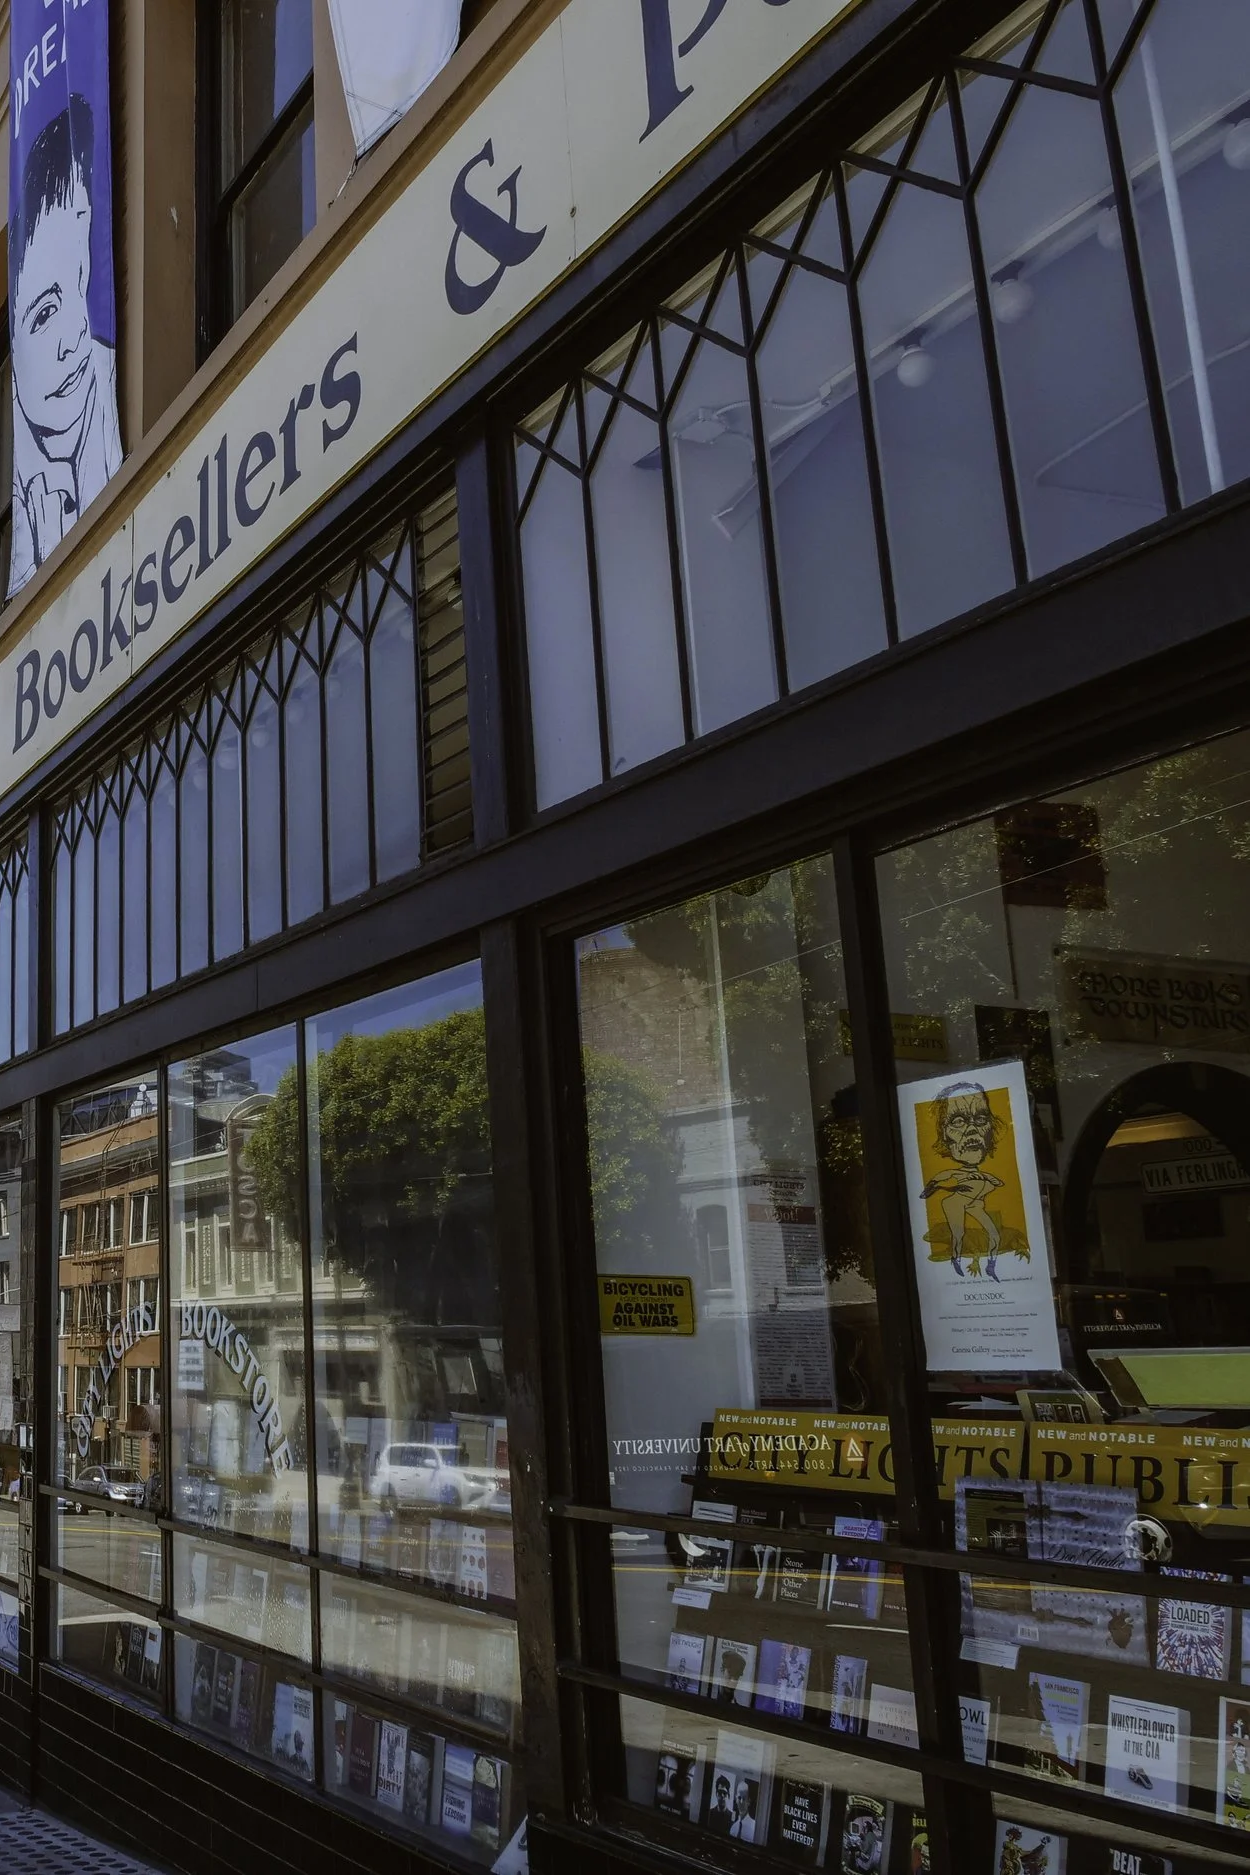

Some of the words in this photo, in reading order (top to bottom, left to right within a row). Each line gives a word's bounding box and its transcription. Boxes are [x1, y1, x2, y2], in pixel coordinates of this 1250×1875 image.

[13, 331, 362, 755] Booksellers
[445, 137, 547, 314] &
[1145, 1167, 1172, 1188] VIA
[603, 1282, 684, 1296] BICYCLING
[614, 1302, 674, 1315] AGAINST
[612, 1315, 636, 1327] OIL
[639, 1315, 679, 1327] WARS
[100, 1302, 152, 1385] LIGHTS
[180, 1300, 295, 1480] BOOKSTORE
[719, 1414, 740, 1423] NEW
[740, 1415, 752, 1424] and
[753, 1416, 797, 1427] NOTABLE
[814, 1419, 835, 1429] NEW
[837, 1420, 850, 1430] and
[946, 1426, 961, 1436] and
[961, 1426, 1016, 1438] NOTABLE
[1037, 1428, 1067, 1440] NEW
[1069, 1430, 1086, 1442] and
[1089, 1430, 1156, 1444] NOTABLE
[1183, 1435, 1216, 1447] NEW
[1219, 1436, 1240, 1448] and
[1042, 1450, 1250, 1510] PUBLI
[785, 1557, 804, 1568] Stone
[780, 1587, 799, 1599] Places
[1171, 1606, 1210, 1625] LOADED
[1111, 1711, 1175, 1743] WHISTLEBLOWER
[1124, 1739, 1131, 1753] AT
[1132, 1741, 1143, 1756] THE
[1145, 1740, 1160, 1761] CIA
[378, 1776, 401, 1796] DIRTY
[794, 1795, 810, 1809] HAVE
[783, 1804, 802, 1819] BLACK
[802, 1810, 818, 1824] LIVES
[791, 1819, 807, 1833] EVER
[782, 1828, 815, 1847] MATTERED?
